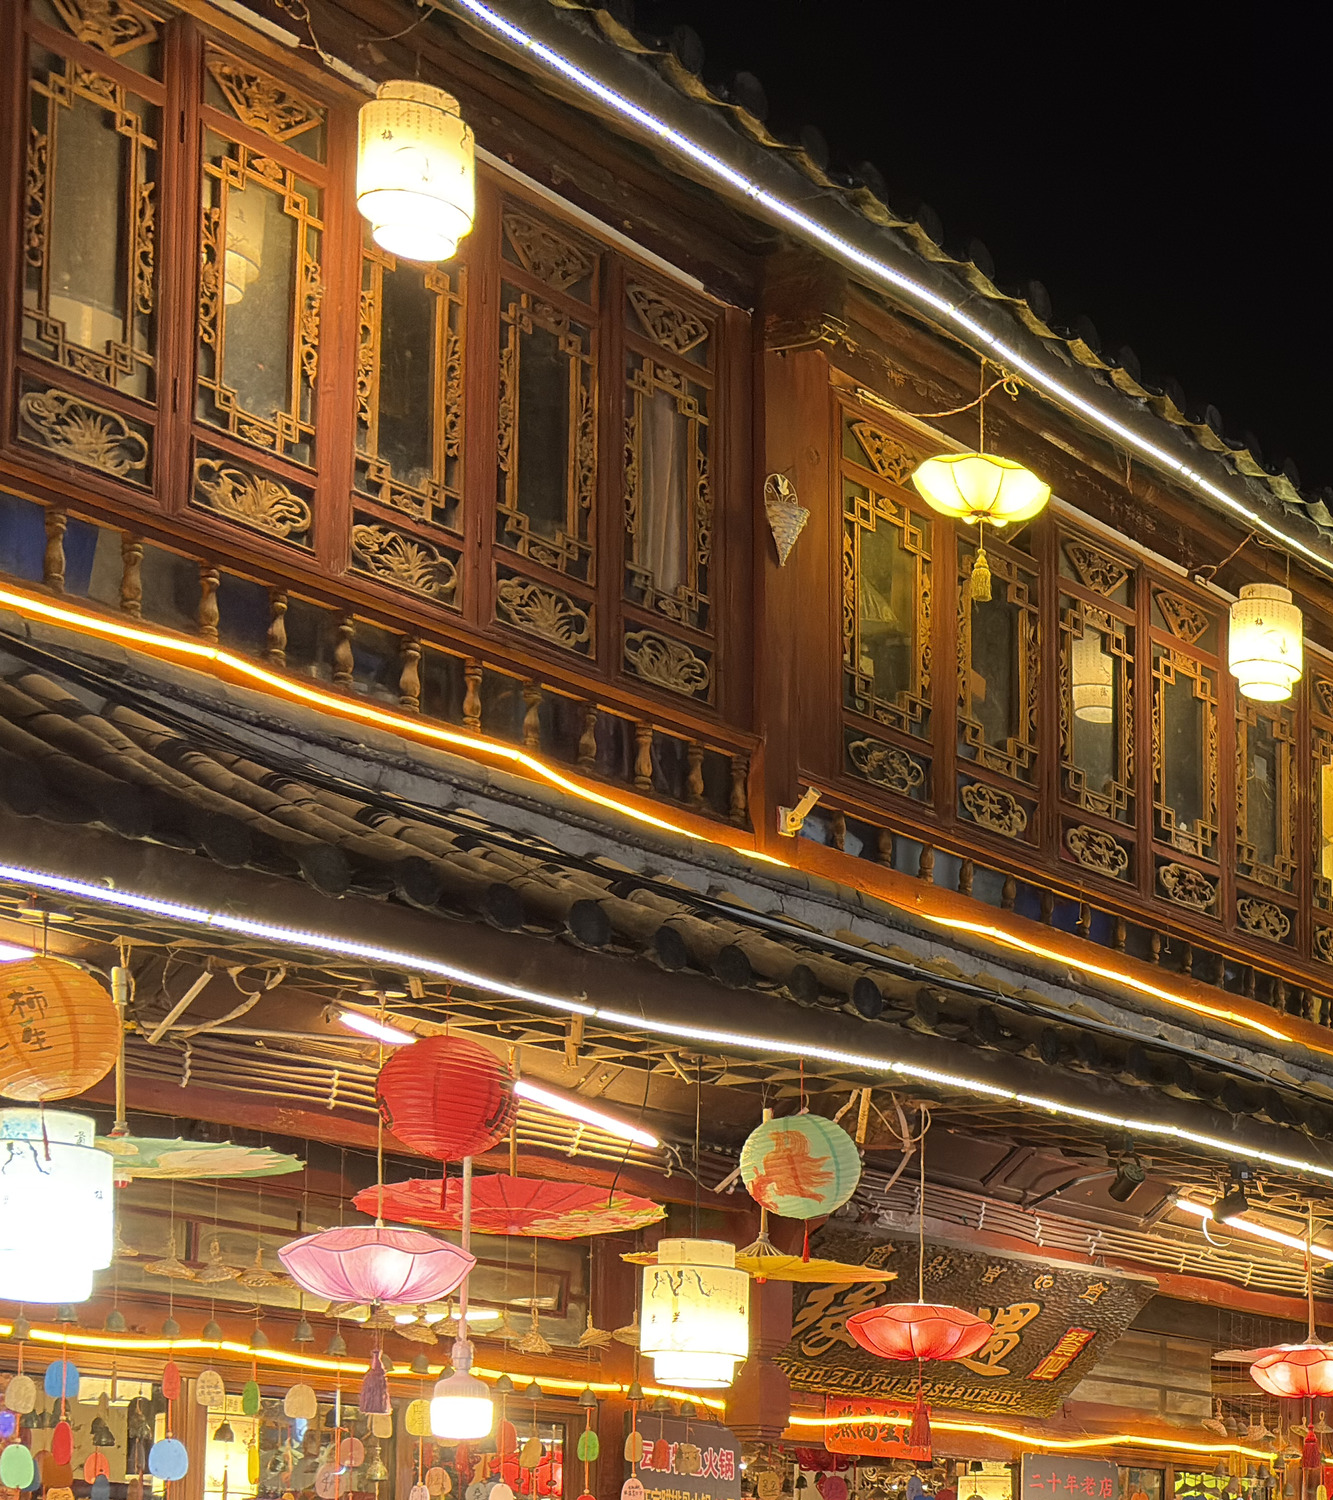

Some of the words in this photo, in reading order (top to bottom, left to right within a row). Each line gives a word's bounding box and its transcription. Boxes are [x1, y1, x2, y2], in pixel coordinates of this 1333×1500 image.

[904, 1378, 1022, 1405] Restaurant
[1029, 1472, 1113, 1499] 二十年老店
